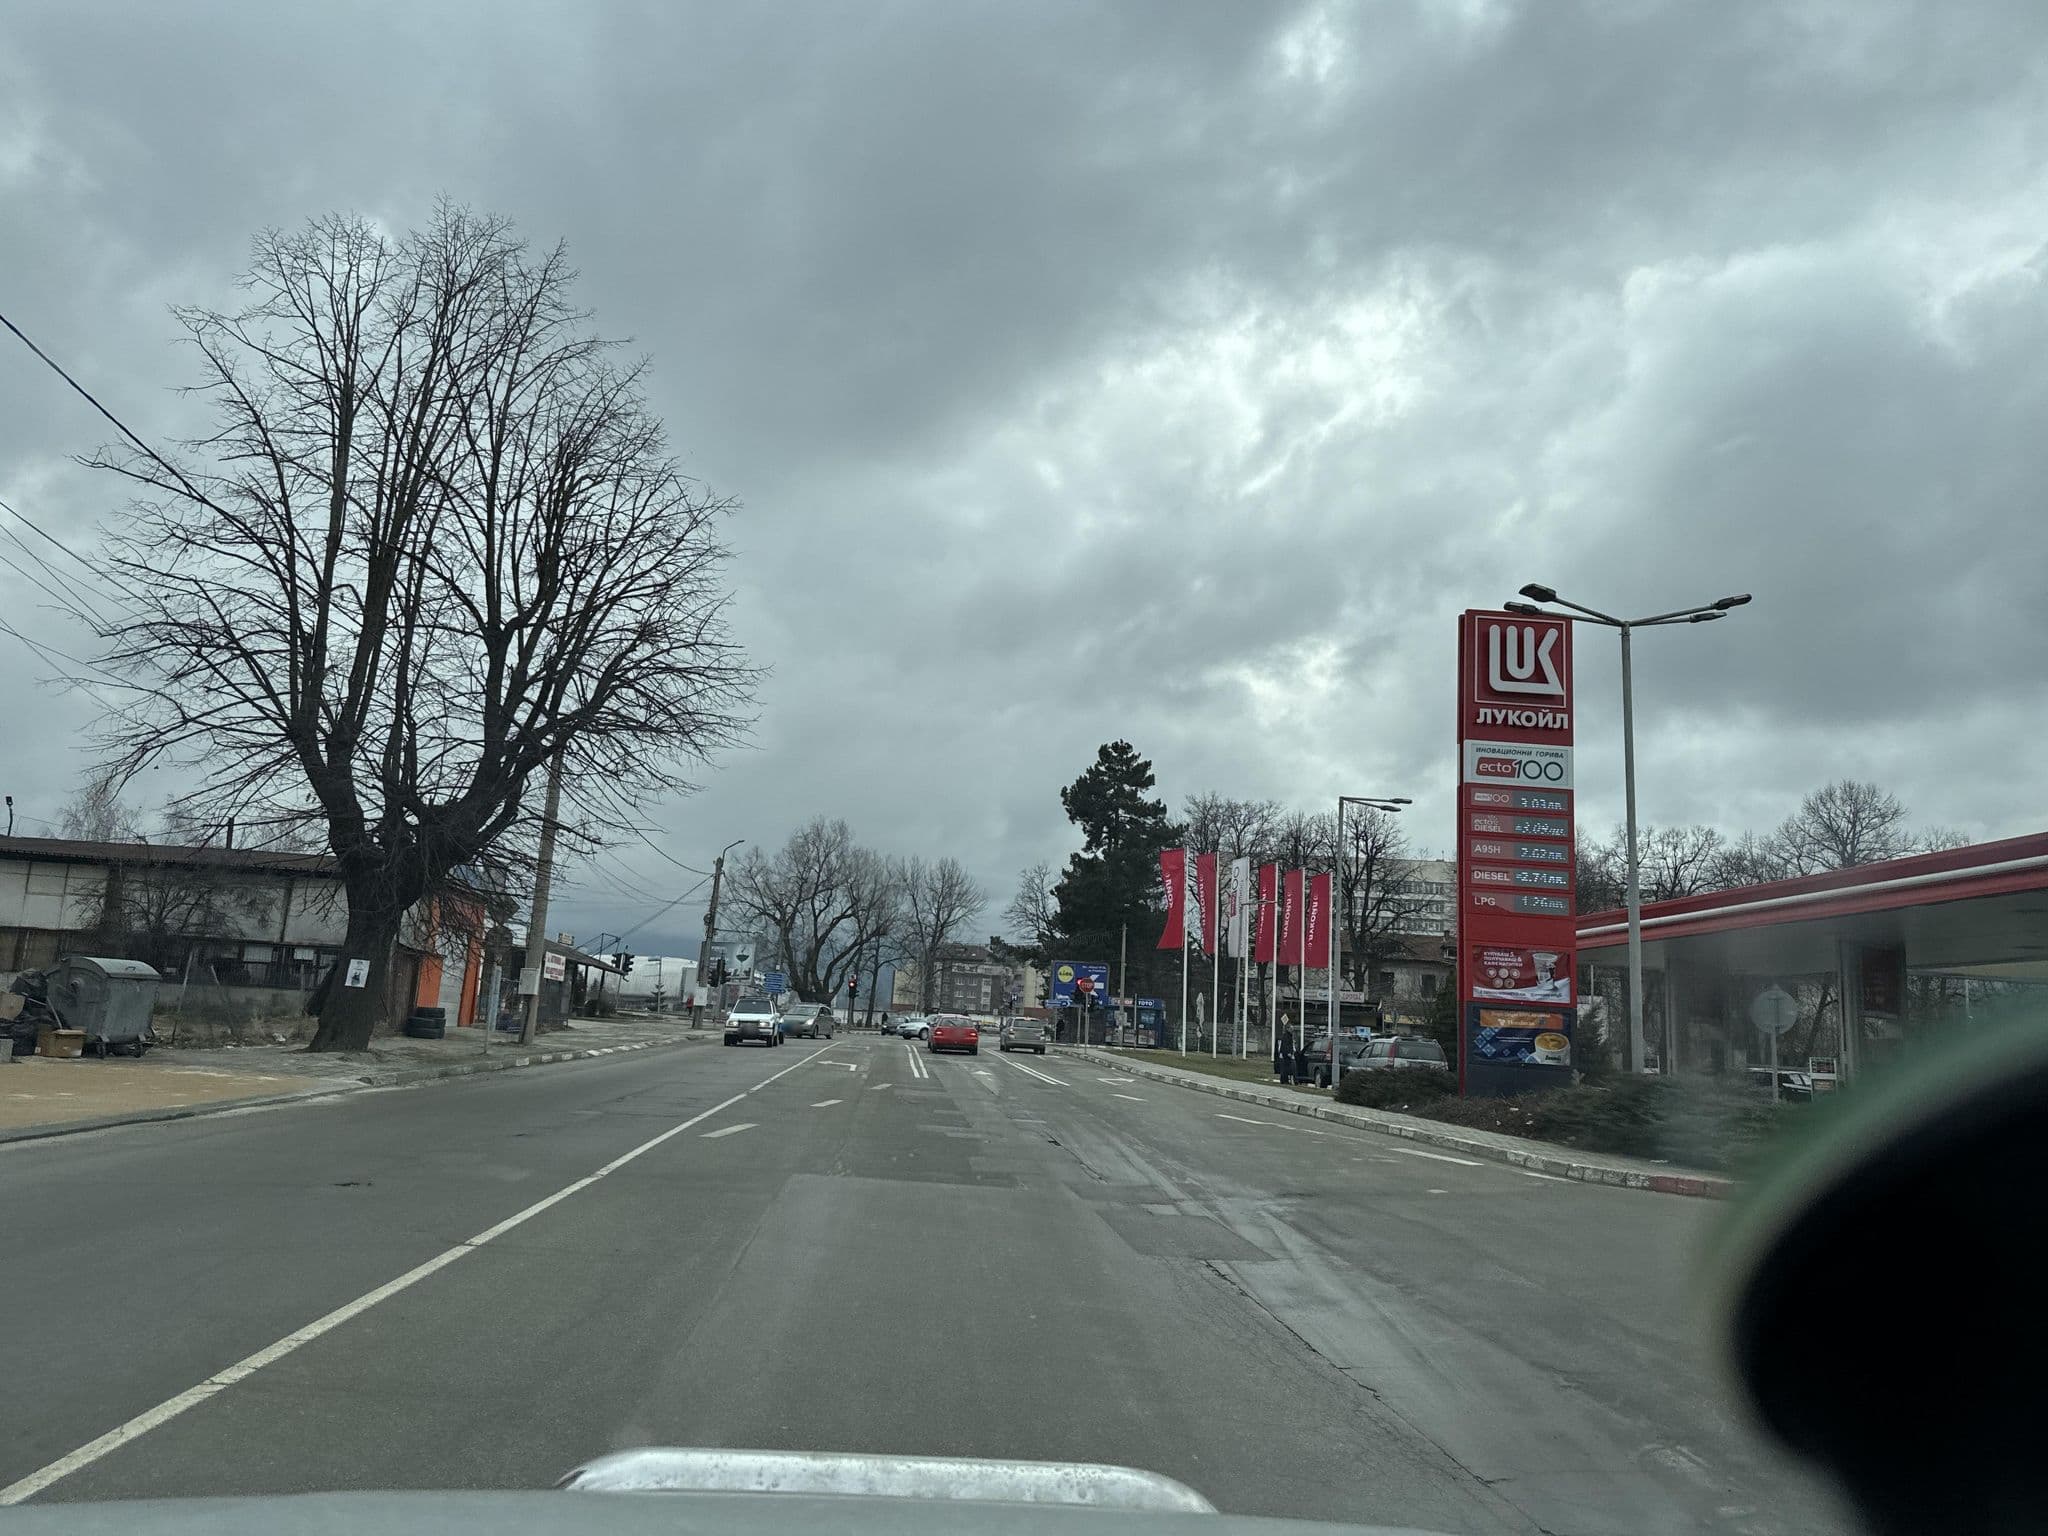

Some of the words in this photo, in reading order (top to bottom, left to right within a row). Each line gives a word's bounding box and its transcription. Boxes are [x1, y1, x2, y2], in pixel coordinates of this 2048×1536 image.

[1476, 707, 1569, 729] ЛУКОЙЛ
[1475, 747, 1532, 756] ИНОВАЦИОННИ
[1535, 751, 1565, 759] ГОРИВА
[1473, 870, 1510, 881] DIESEL
[1474, 896, 1496, 906] LPG
